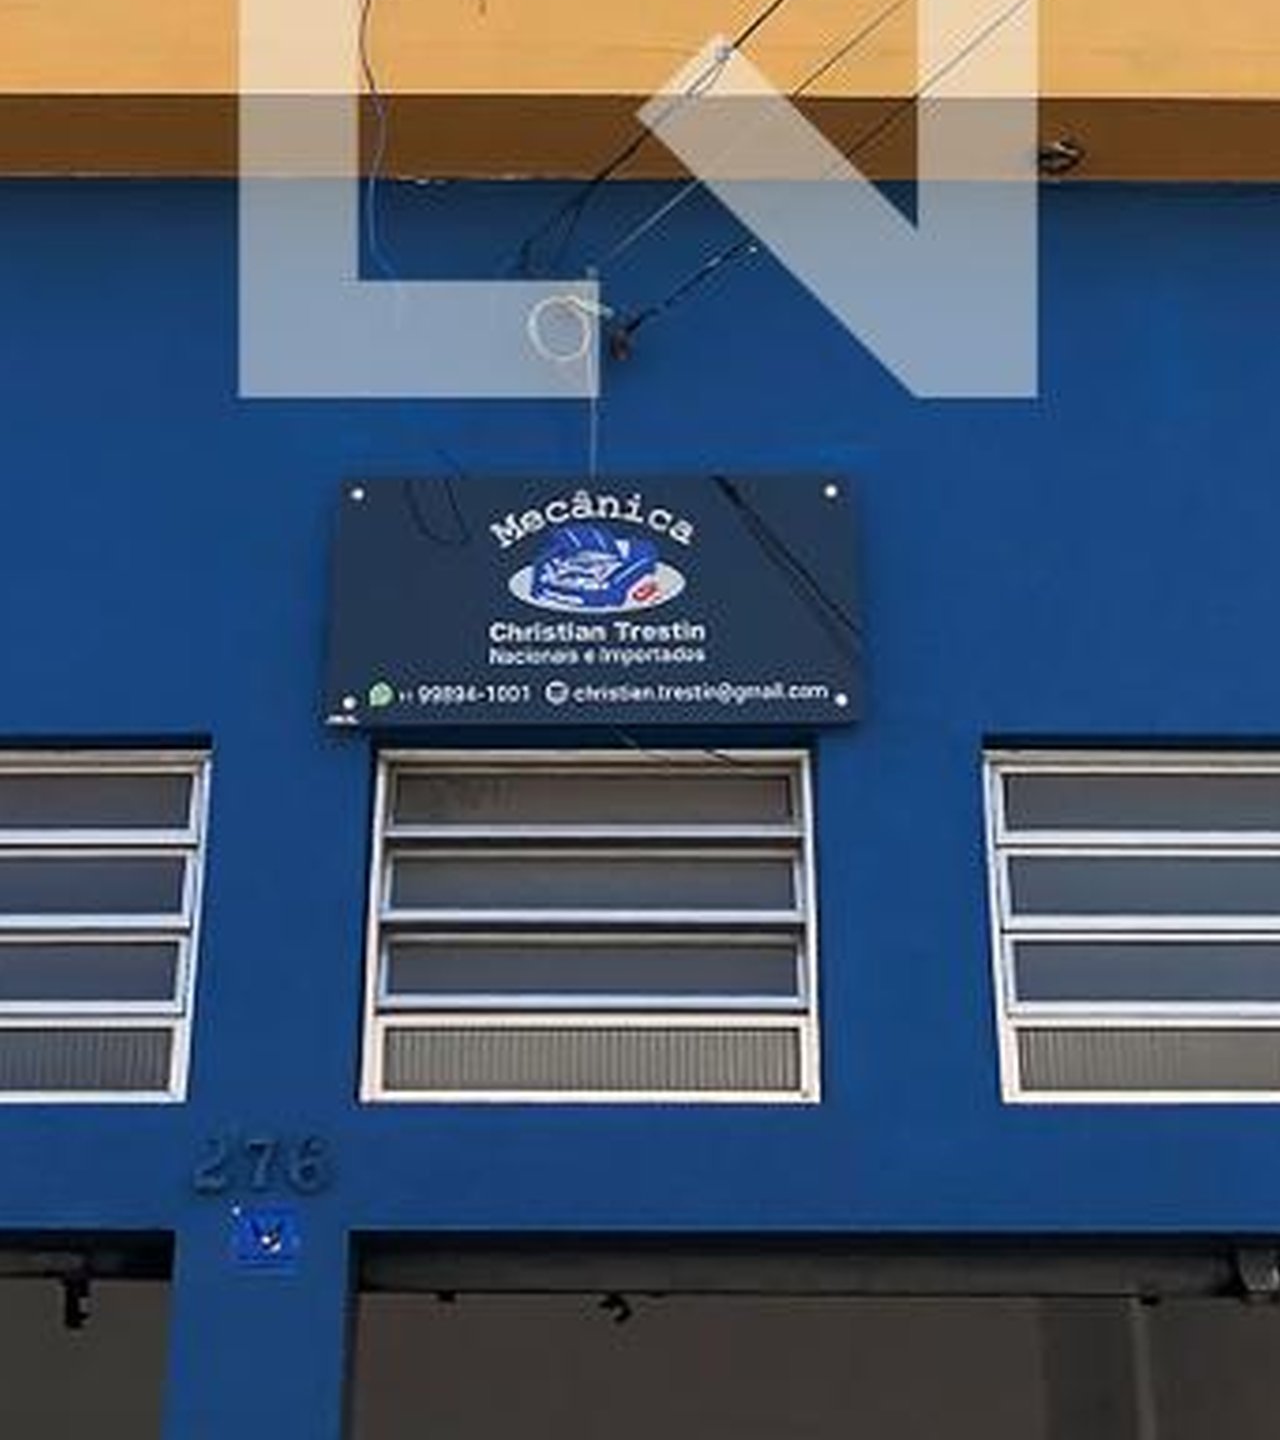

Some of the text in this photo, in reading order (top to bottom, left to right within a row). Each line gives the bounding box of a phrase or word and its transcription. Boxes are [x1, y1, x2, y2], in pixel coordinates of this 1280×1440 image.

[489, 489, 695, 548] Mecânica
[489, 621, 706, 642] Christian Trestin
[489, 647, 579, 664] Nacionais
[599, 645, 706, 666] Importados
[194, 1134, 328, 1195] 276
